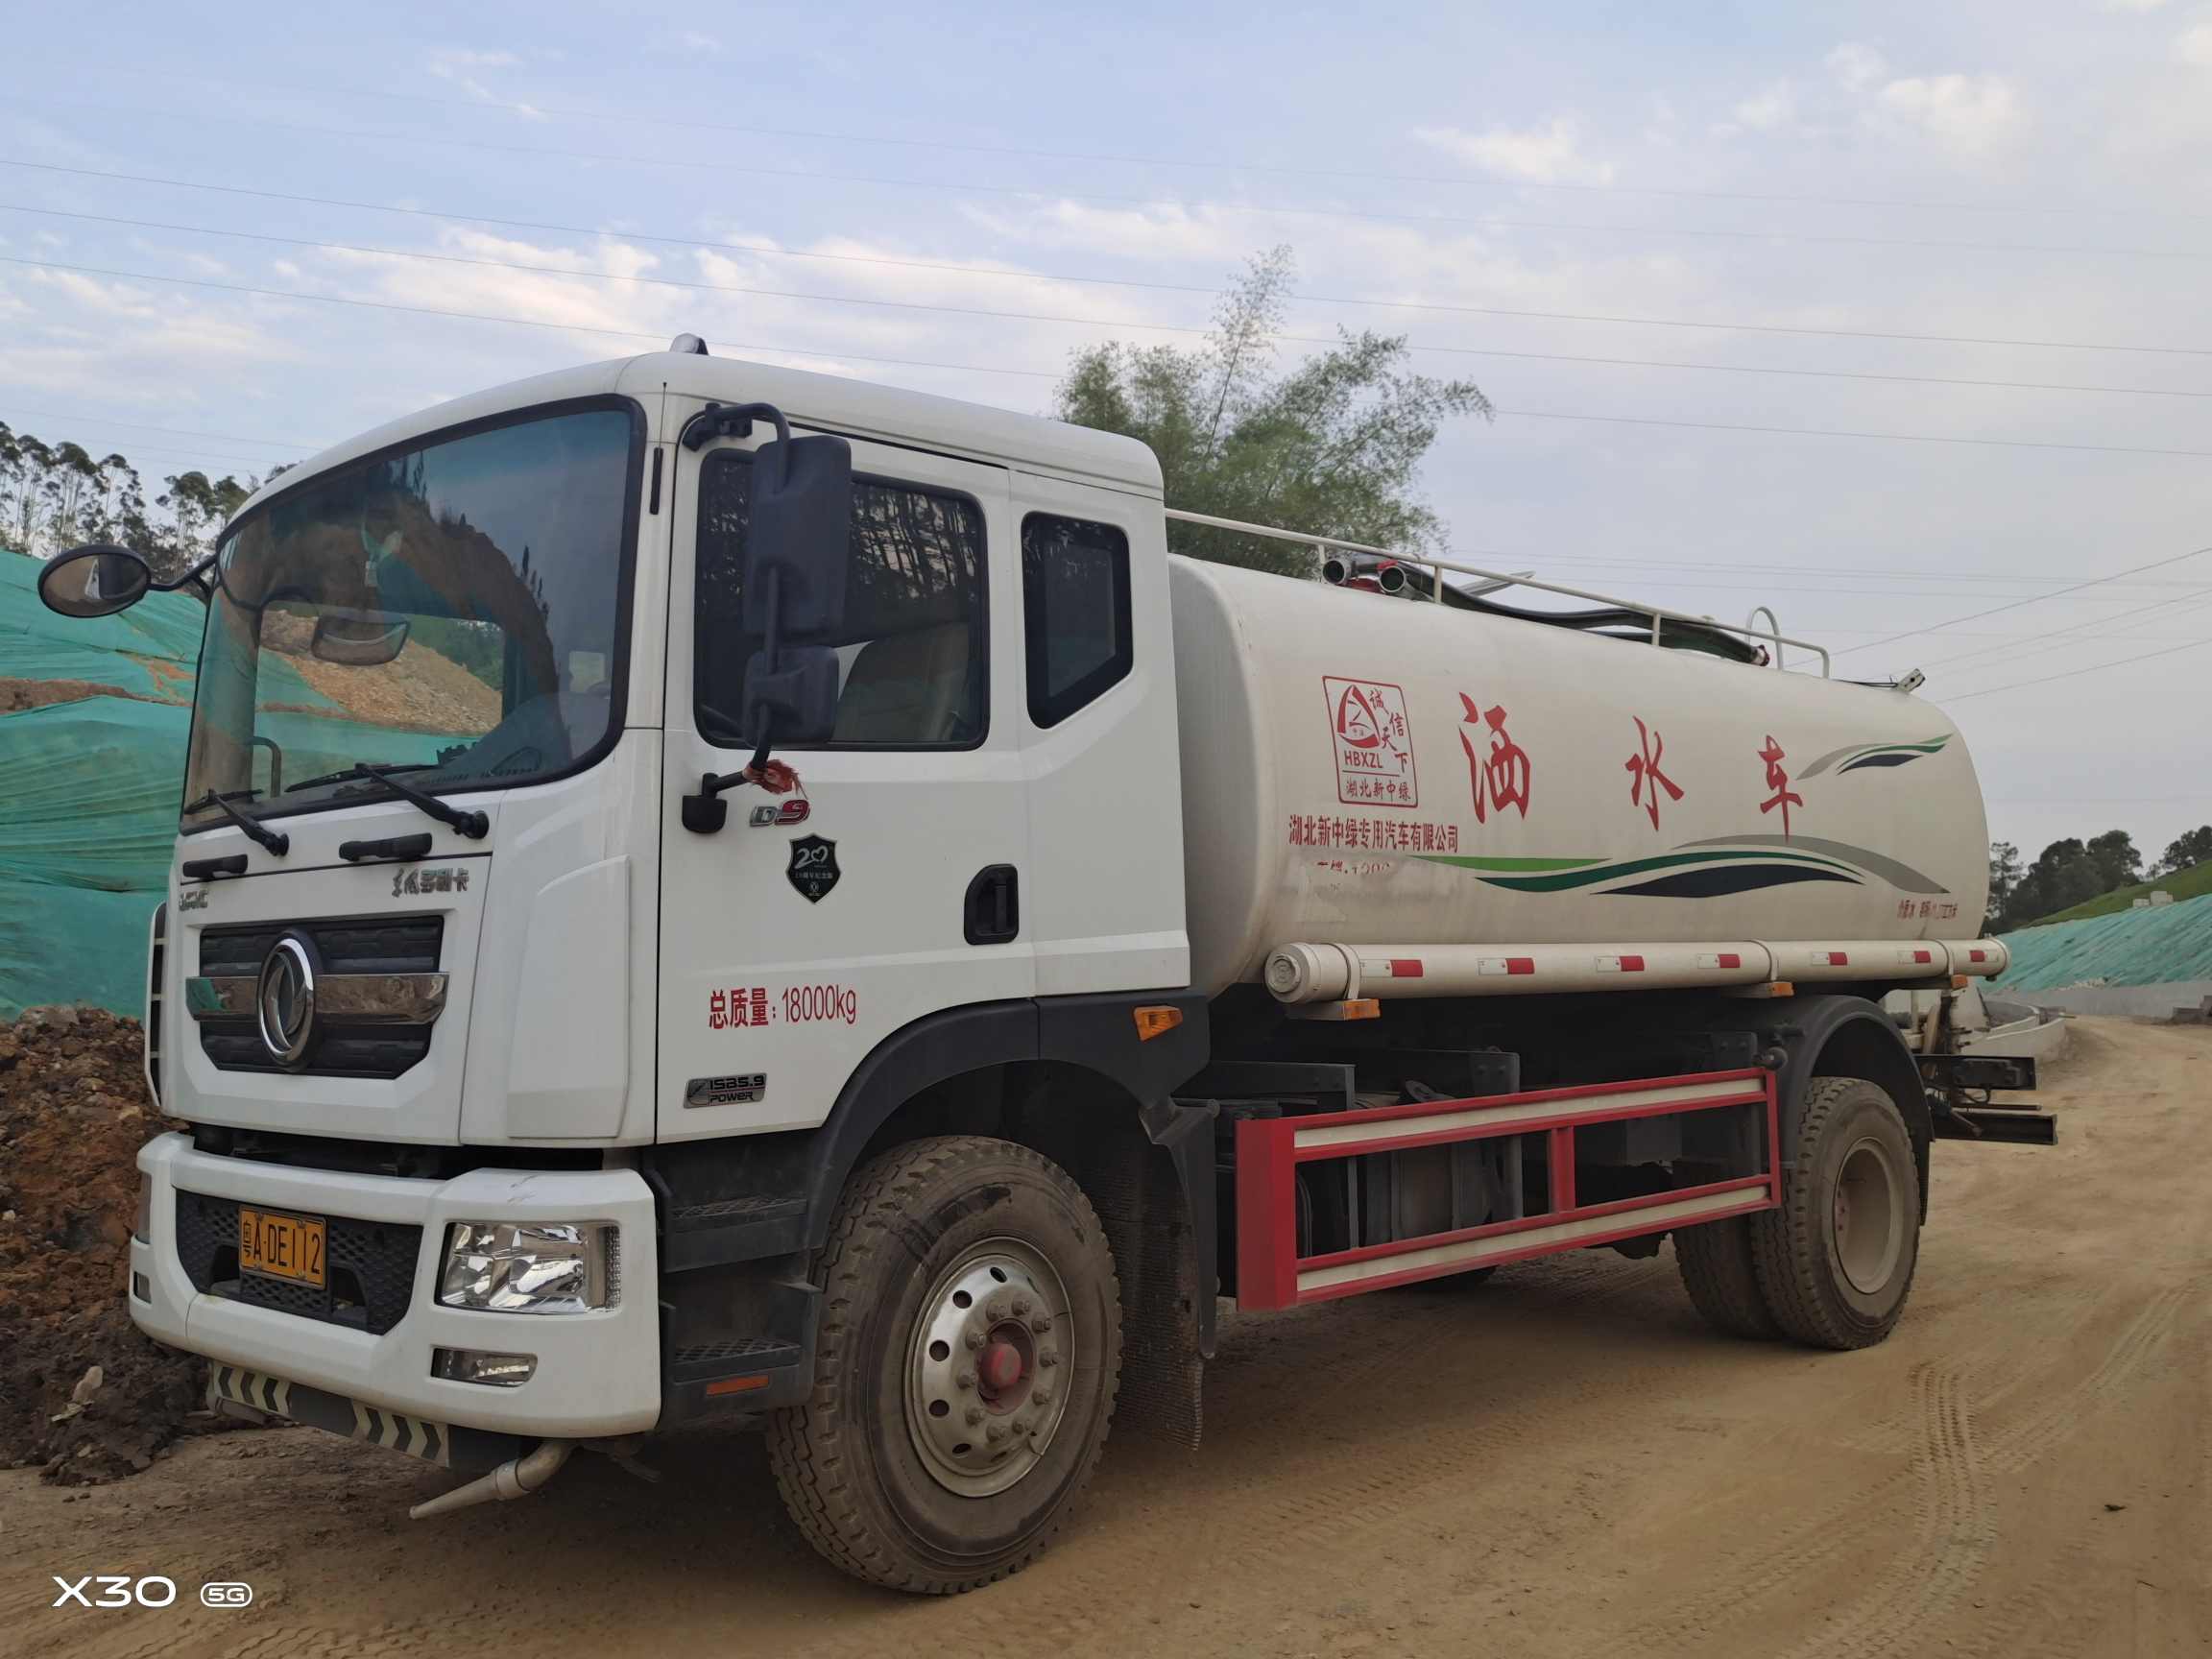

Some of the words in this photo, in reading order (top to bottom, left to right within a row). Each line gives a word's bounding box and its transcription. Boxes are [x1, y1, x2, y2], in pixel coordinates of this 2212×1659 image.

[1344, 750, 1383, 769] HBXZL
[1457, 690, 1803, 843] 洒水车
[1346, 776, 1410, 803] 湖北新中绿
[1288, 814, 1458, 854] 湖北新中绿专用汽车有限公司
[709, 1091, 754, 1103] POWER
